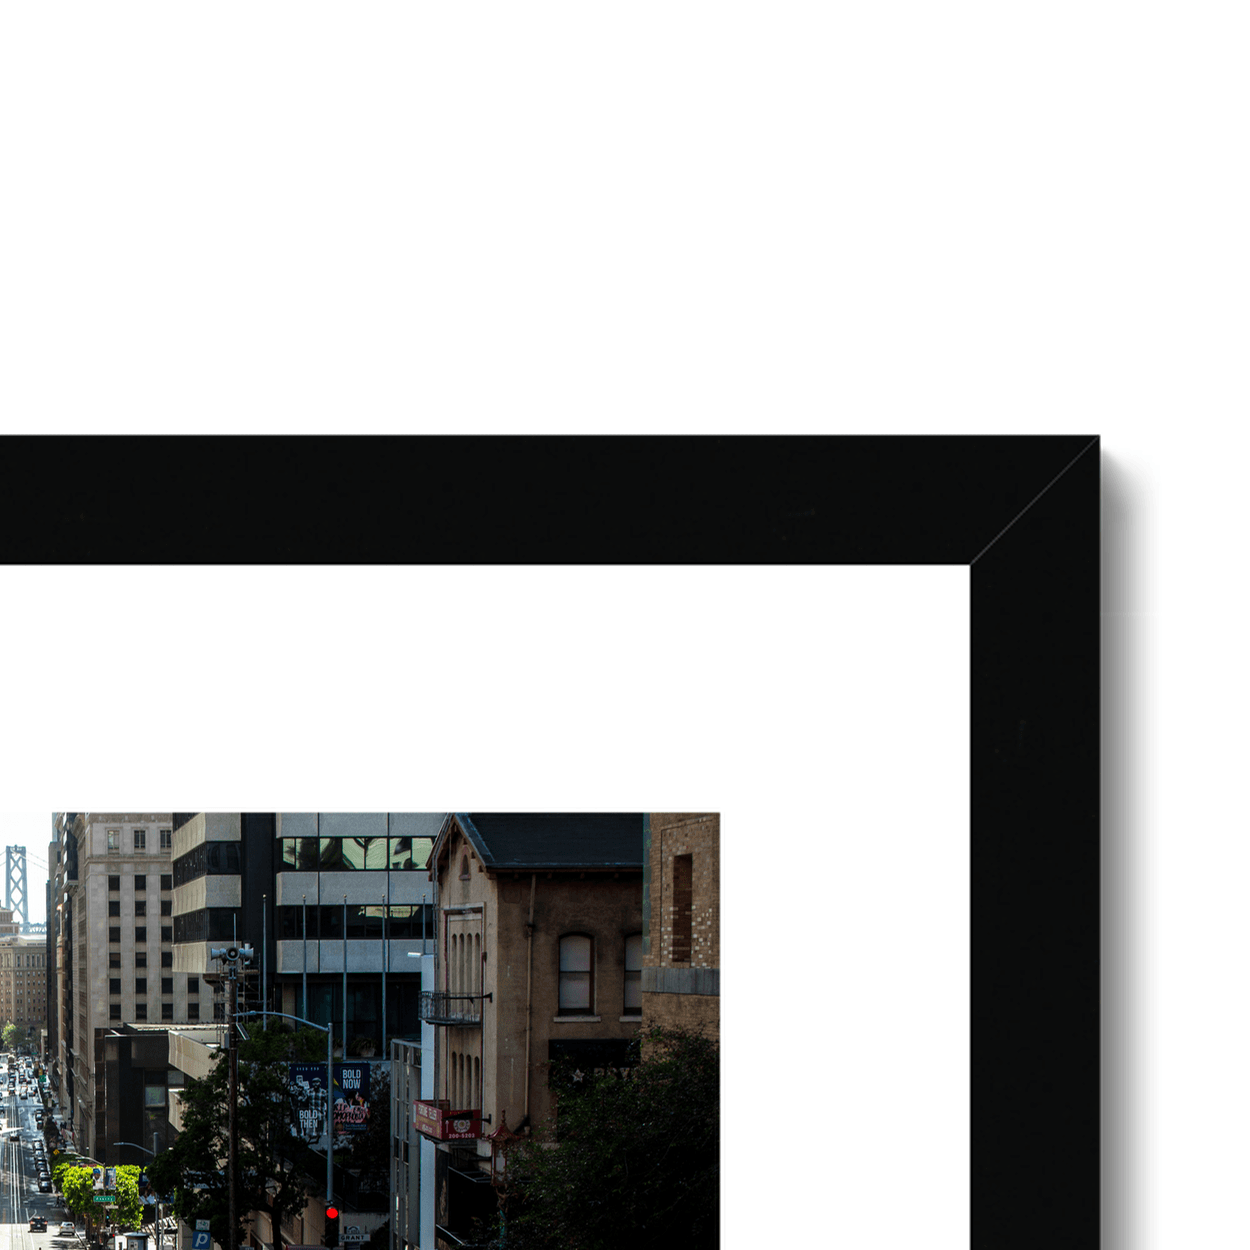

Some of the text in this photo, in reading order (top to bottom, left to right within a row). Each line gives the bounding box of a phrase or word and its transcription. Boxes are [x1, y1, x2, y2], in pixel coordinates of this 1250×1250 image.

[342, 1069, 361, 1079] BOLD
[342, 1079, 361, 1089] NOW
[299, 1109, 318, 1119] BOLD
[299, 1119, 318, 1128] THEN
